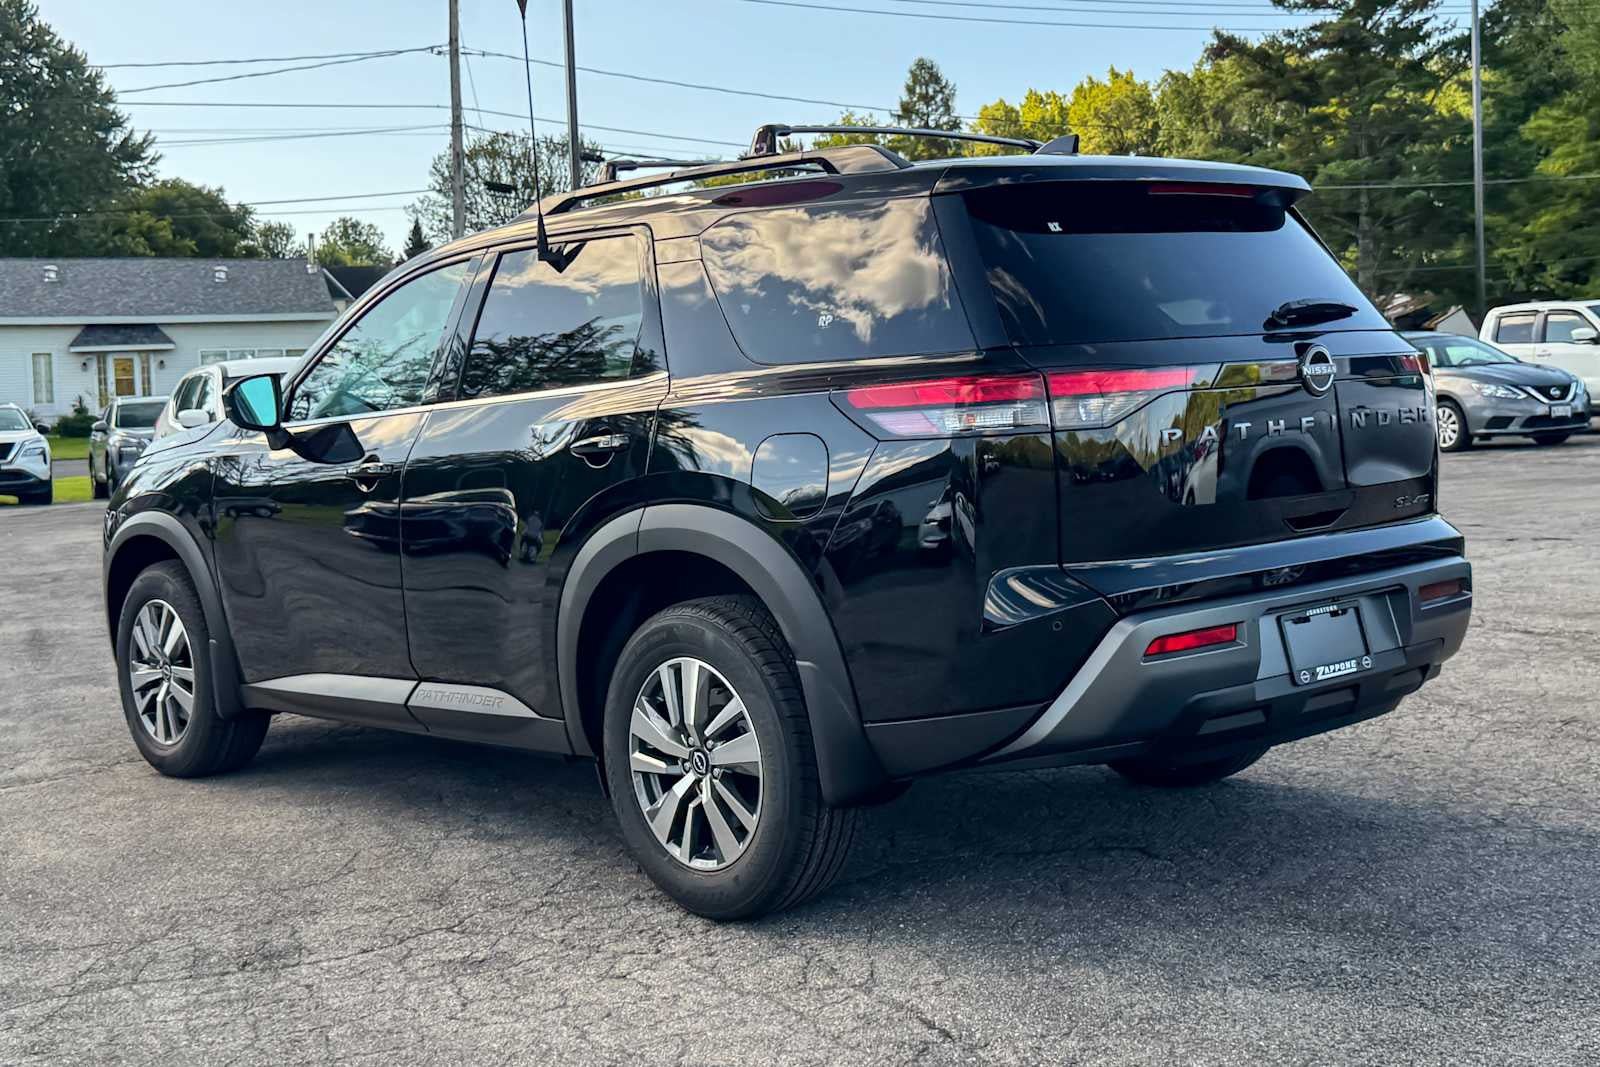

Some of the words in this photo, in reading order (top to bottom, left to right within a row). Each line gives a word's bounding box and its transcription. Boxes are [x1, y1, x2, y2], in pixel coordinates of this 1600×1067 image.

[1303, 364, 1337, 376] NISSAN
[1160, 405, 1428, 447] PATHFINDER
[1316, 659, 1358, 681] ZAPPONE
[415, 688, 505, 709] PATHFINDER
